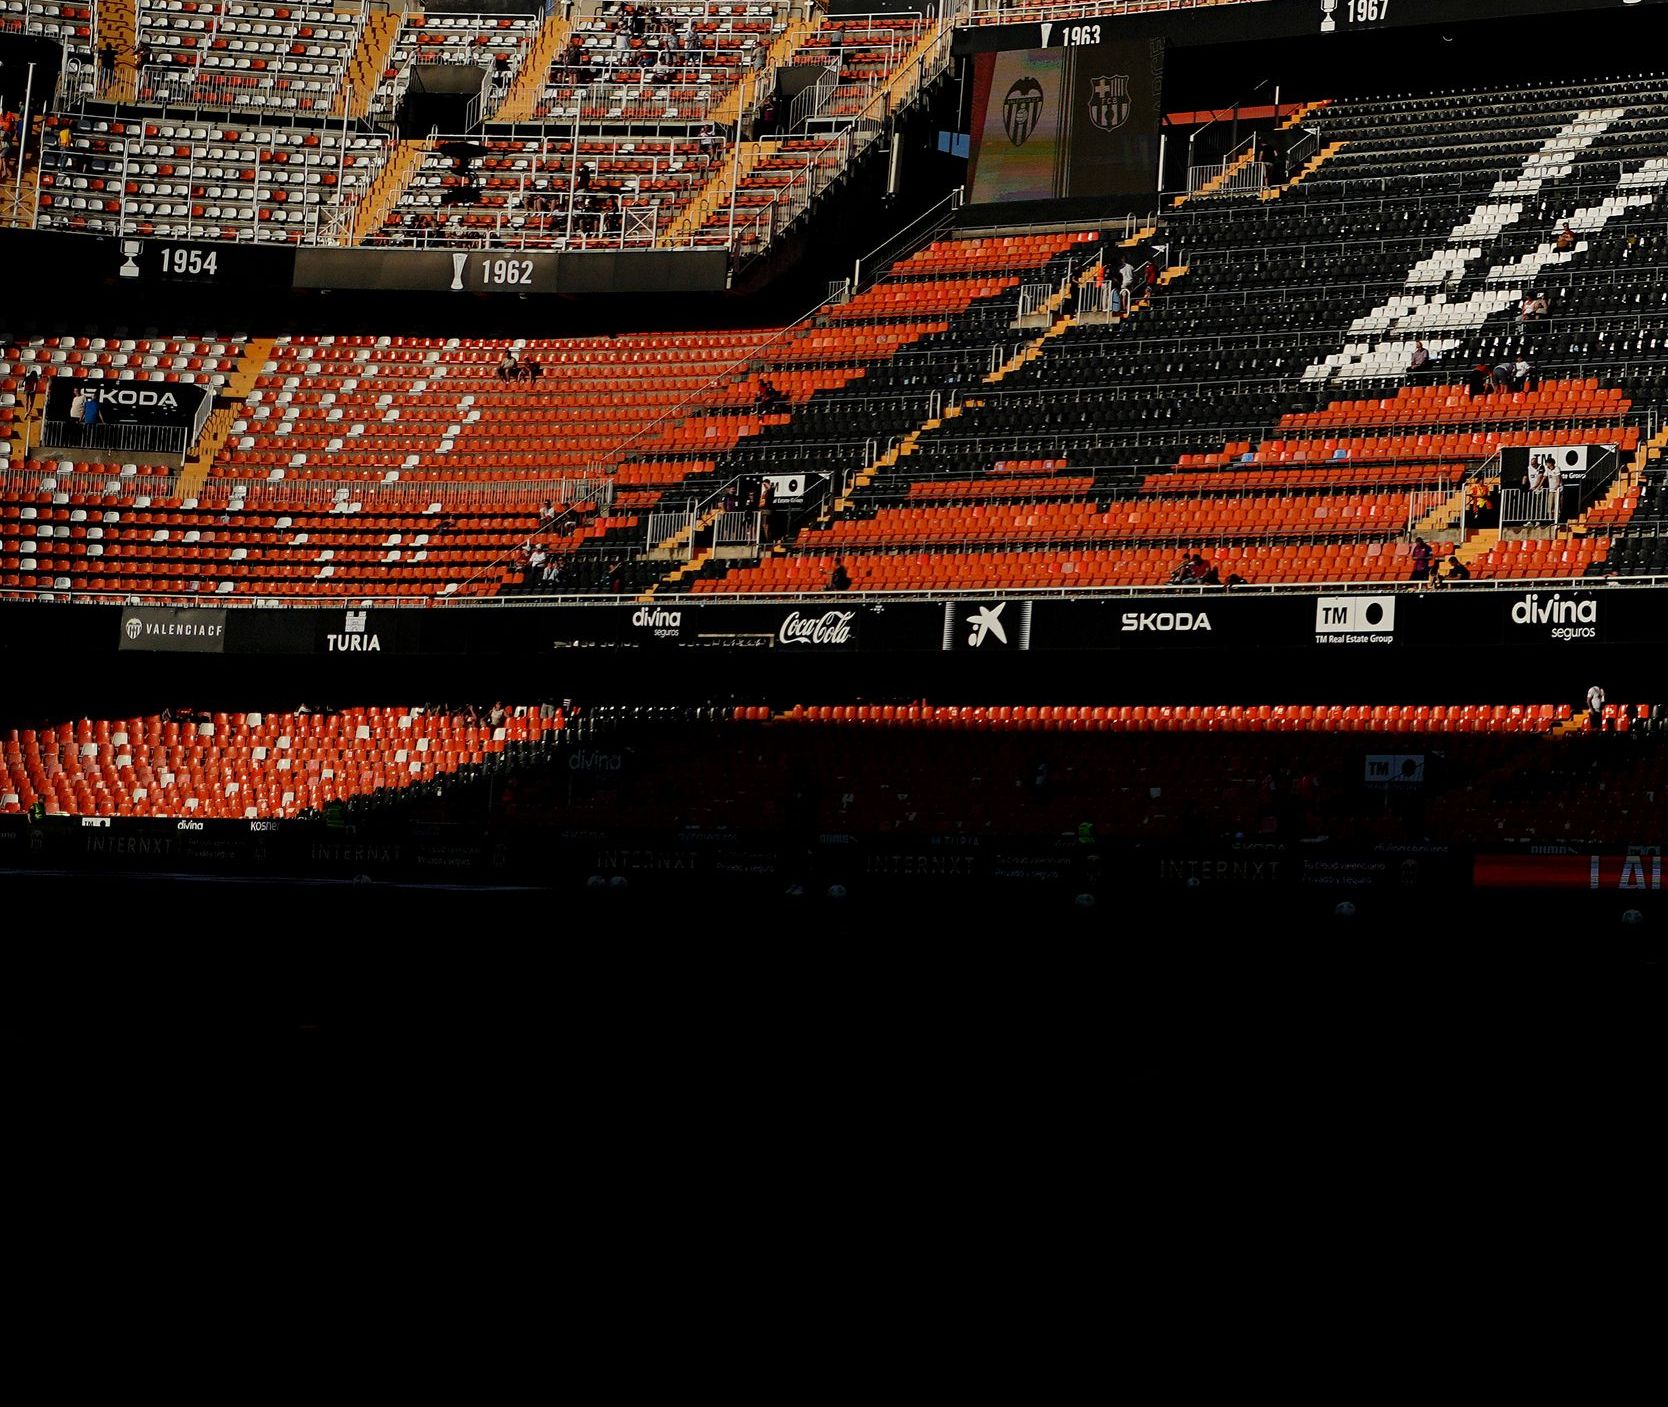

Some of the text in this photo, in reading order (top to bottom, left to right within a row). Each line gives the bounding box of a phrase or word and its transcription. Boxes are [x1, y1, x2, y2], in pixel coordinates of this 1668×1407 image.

[1062, 25, 1101, 46] 1963
[162, 249, 217, 274] 1954
[483, 255, 533, 283] 1962
[632, 607, 681, 627] divina
[1322, 607, 1347, 624] TM
[1511, 594, 1597, 624] divina
[779, 611, 856, 644] Coca-Cola
[1122, 613, 1211, 630] SKODA
[654, 628, 679, 637] seguros
[1315, 634, 1393, 644] TM Real Estate Group
[1551, 626, 1596, 641] seguros
[327, 634, 381, 651] TURIA
[568, 750, 622, 771] divina
[1368, 761, 1388, 776] TM
[177, 821, 204, 830] divina
